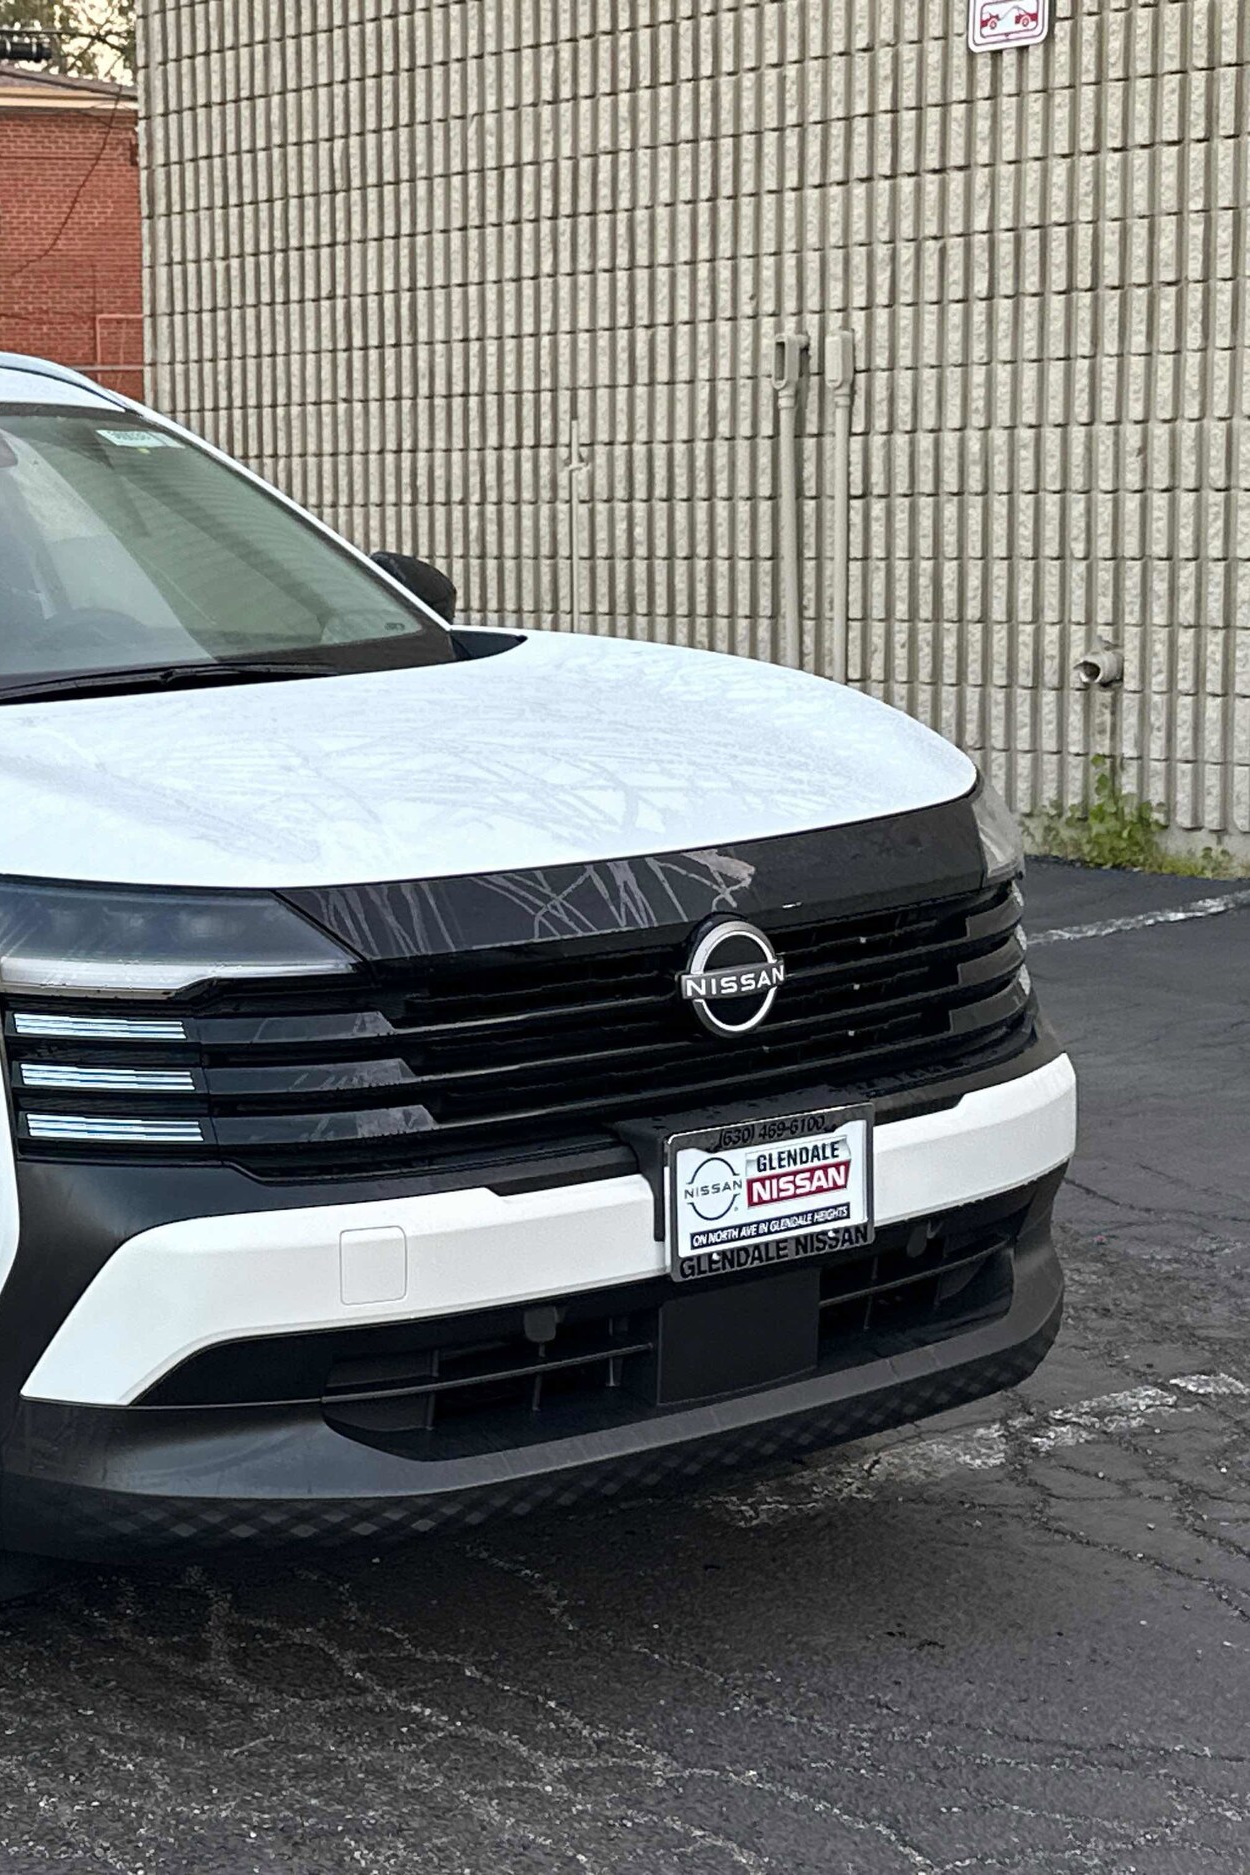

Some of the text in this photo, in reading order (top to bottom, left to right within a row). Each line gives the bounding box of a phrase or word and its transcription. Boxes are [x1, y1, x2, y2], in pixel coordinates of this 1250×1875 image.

[686, 965, 785, 997] NISSAN
[718, 1115, 825, 1147] (630) 469-6100
[756, 1141, 840, 1172] GLENDALE
[684, 1179, 743, 1199] NISSAN
[752, 1165, 847, 1203] NISSAN
[692, 1205, 848, 1247] ON NORTH AVE IN GLENDALE HEIGHTS
[680, 1226, 869, 1280] GLENDALE NISSAN
